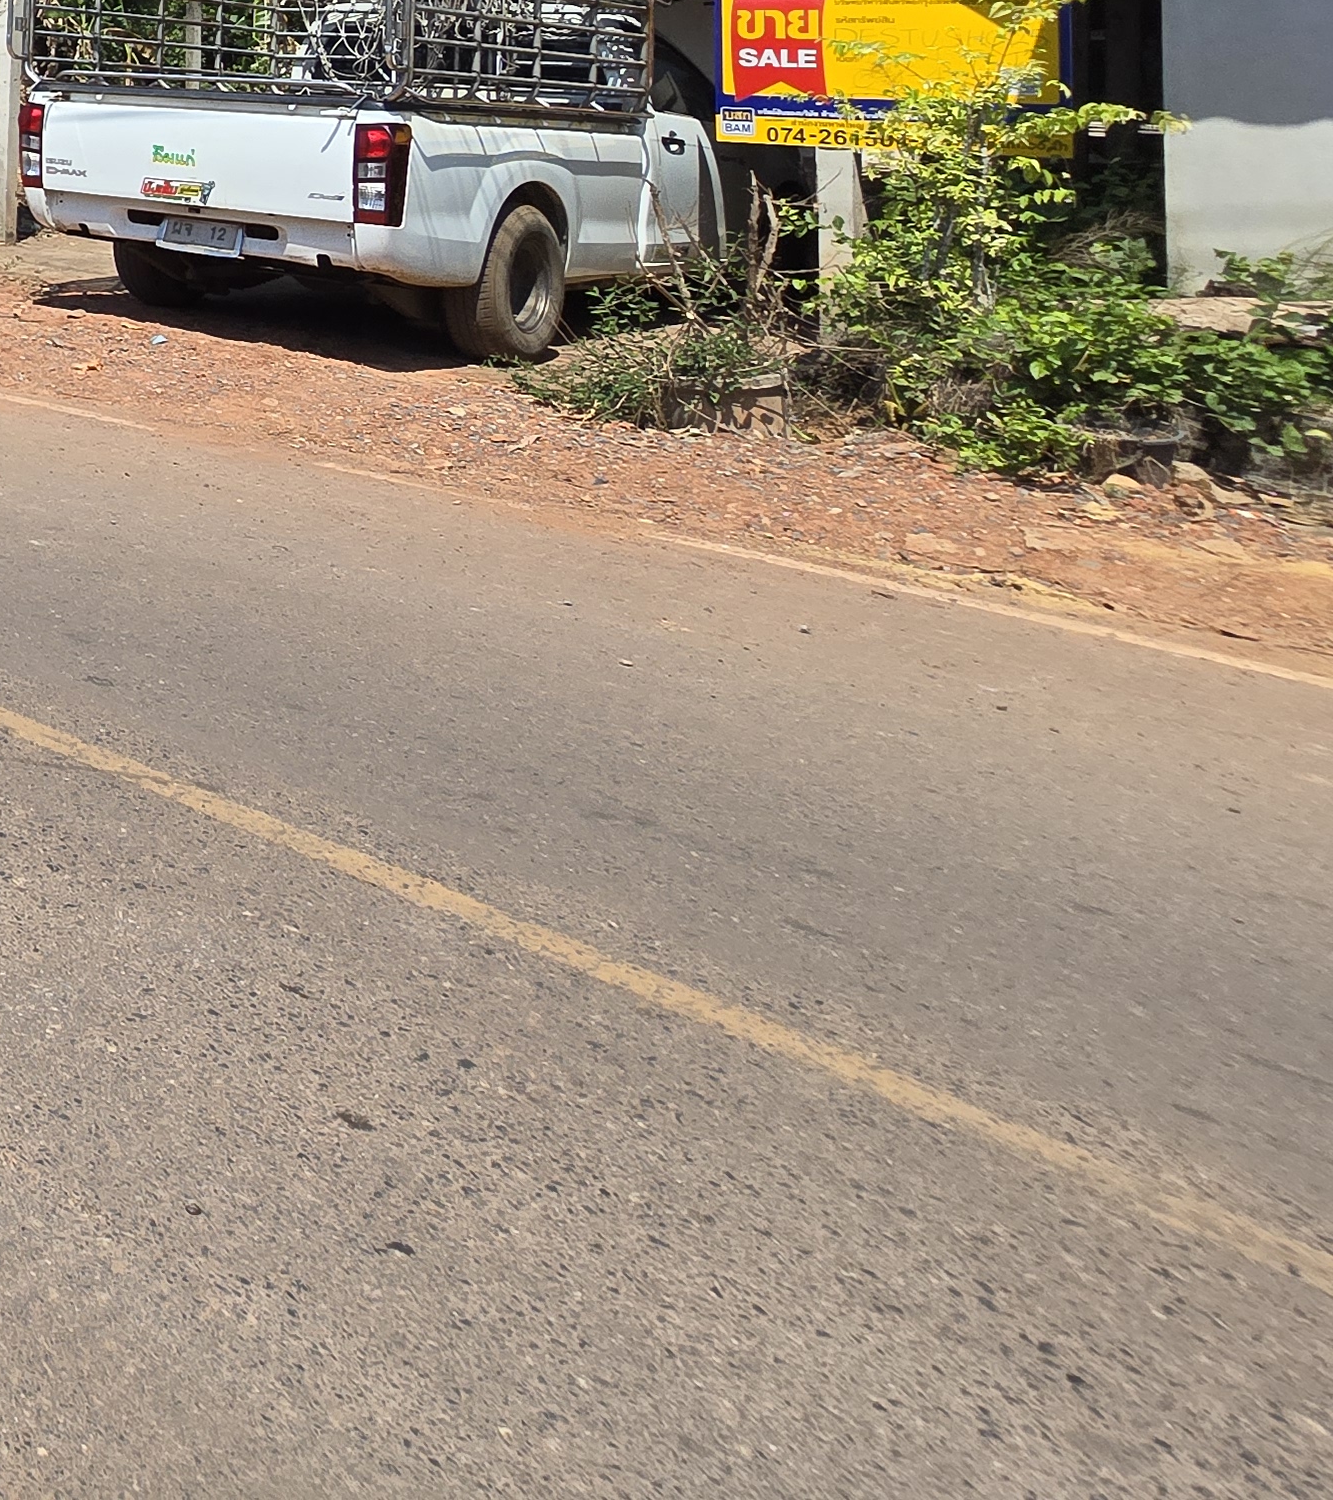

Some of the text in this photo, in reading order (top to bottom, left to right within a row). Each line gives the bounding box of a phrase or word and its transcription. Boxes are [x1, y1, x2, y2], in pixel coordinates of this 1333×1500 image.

[736, 9, 819, 40] ขาย
[738, 48, 818, 68] SALE
[724, 110, 751, 120] บสก
[724, 123, 751, 133] BAM
[46, 166, 87, 177] D-MAX
